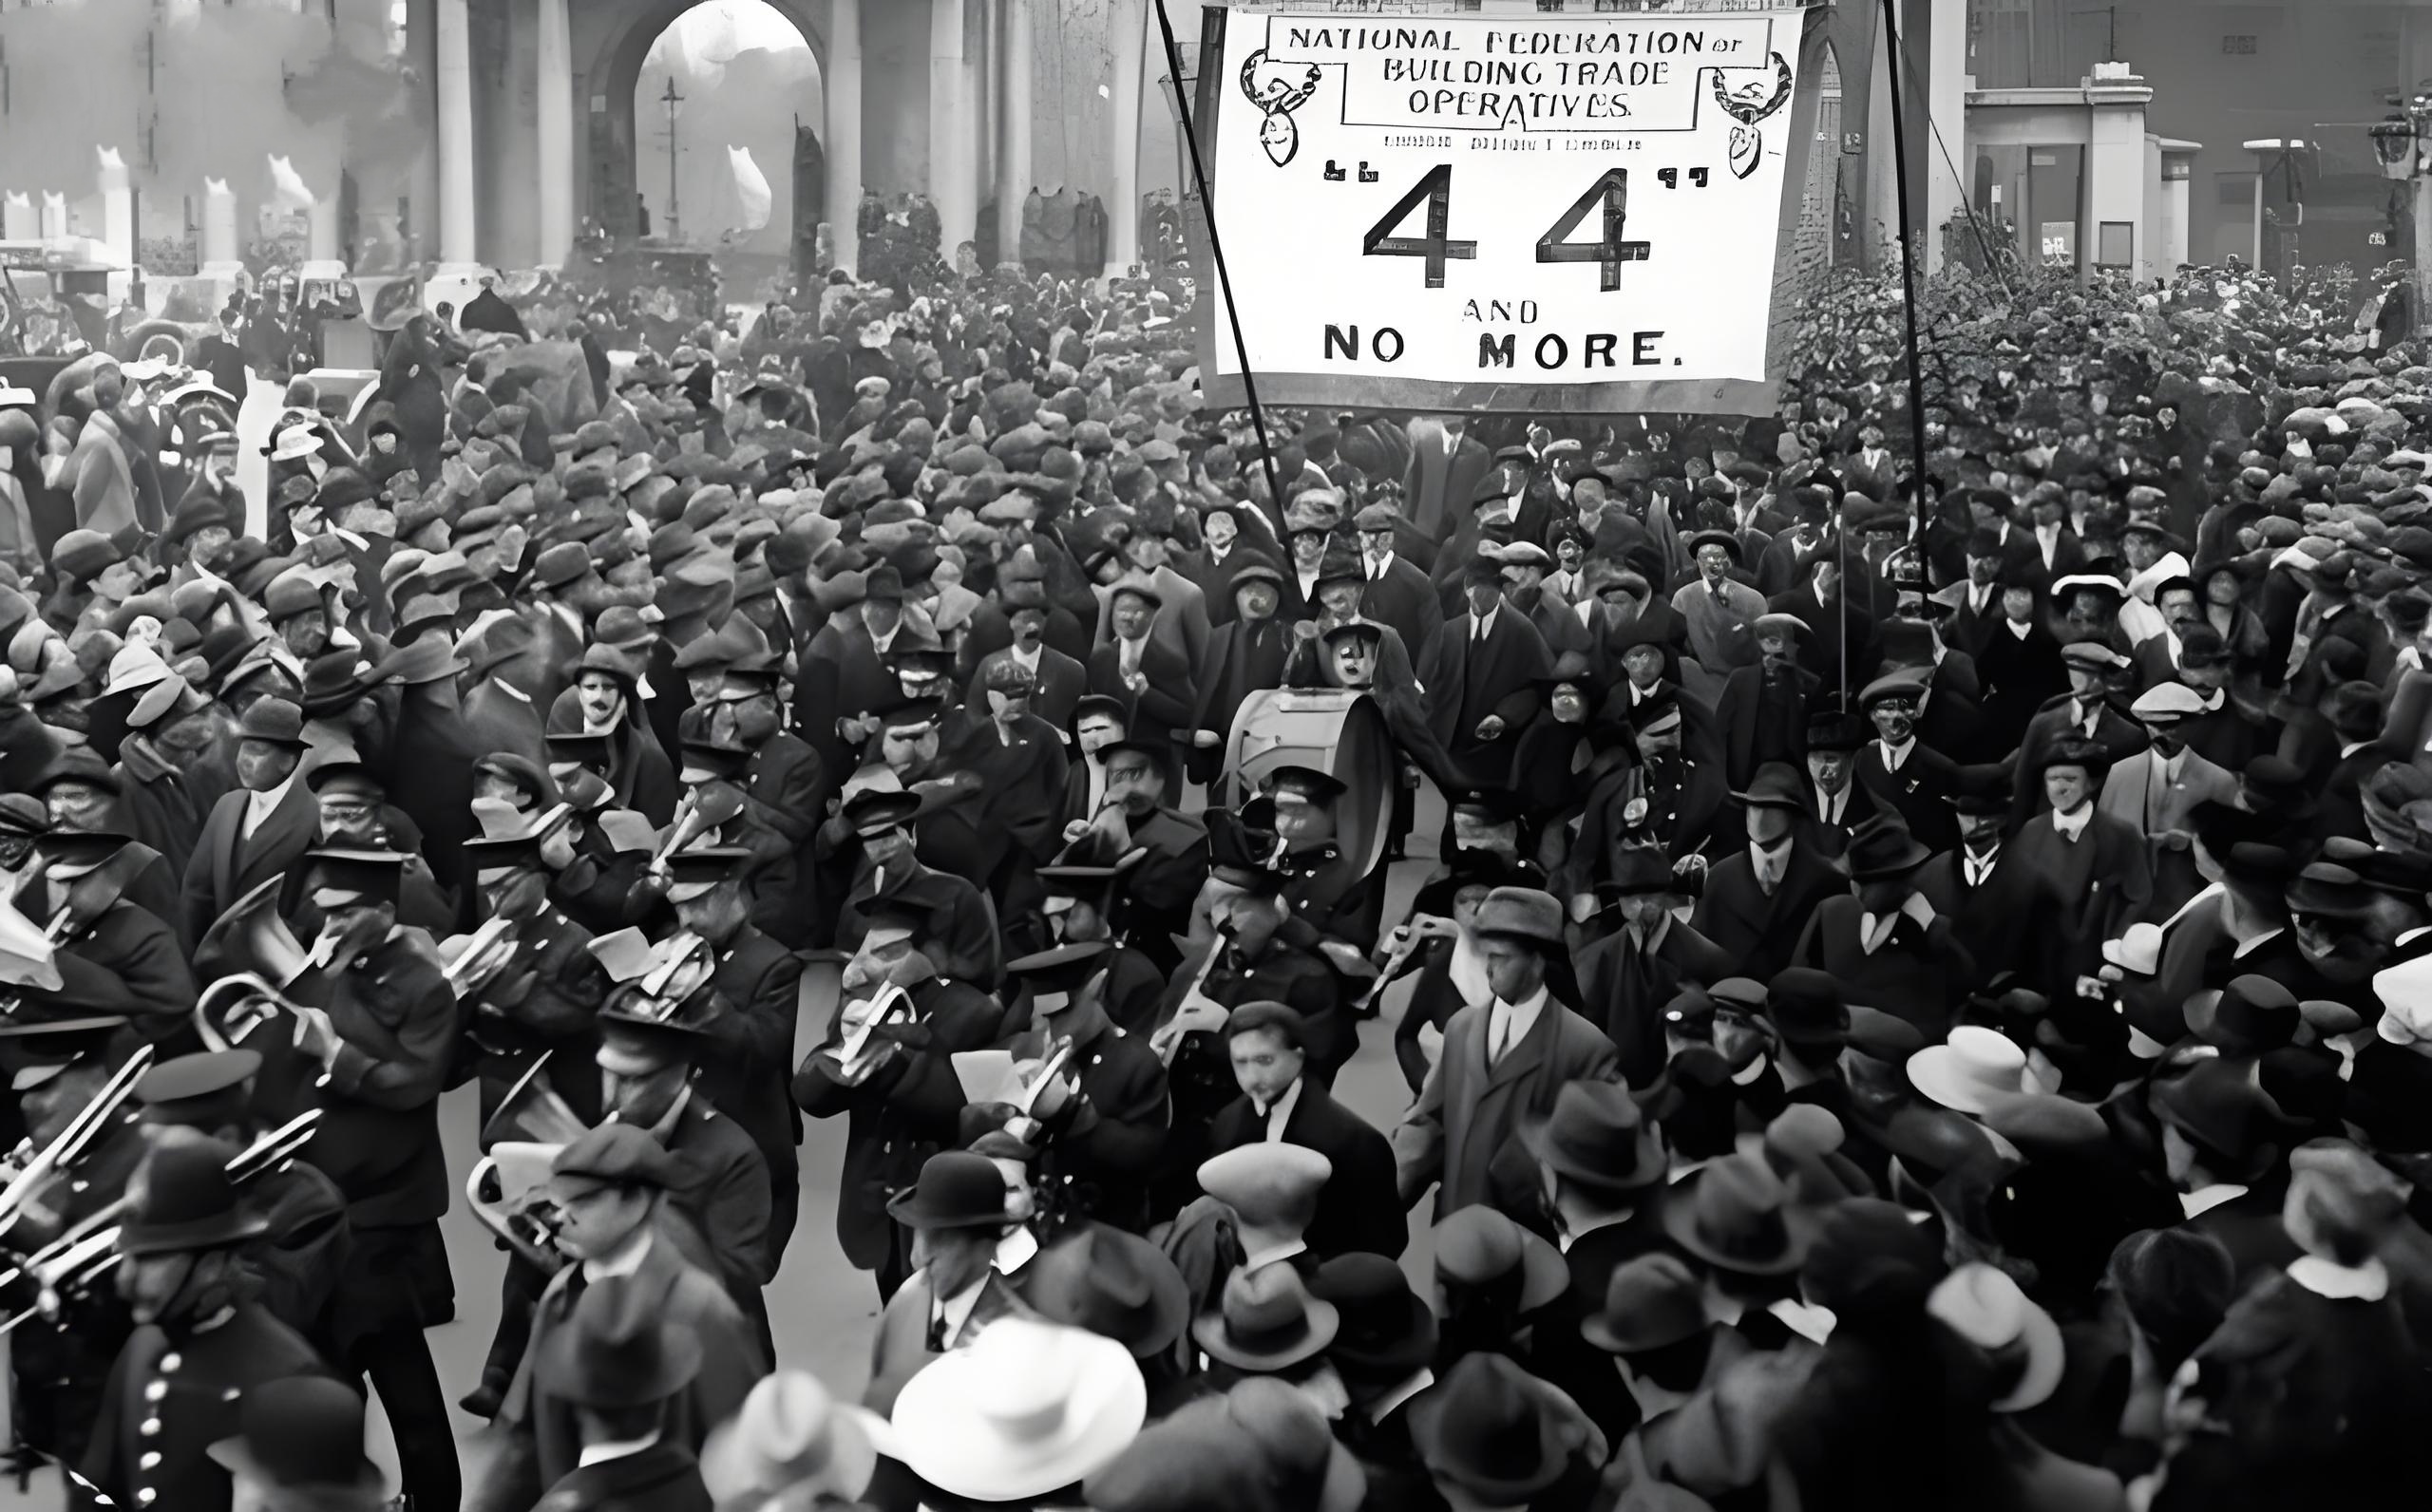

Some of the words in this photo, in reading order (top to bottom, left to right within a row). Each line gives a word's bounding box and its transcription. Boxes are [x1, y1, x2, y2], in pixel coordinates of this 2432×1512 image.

[1289, 28, 1460, 50] NATIONAL
[1383, 58, 1543, 85] BUILDING
[1555, 61, 1669, 86] TRADE
[1462, 298, 1538, 325] AND
[1323, 323, 1405, 363] NO
[1478, 331, 1682, 369] MORE.
